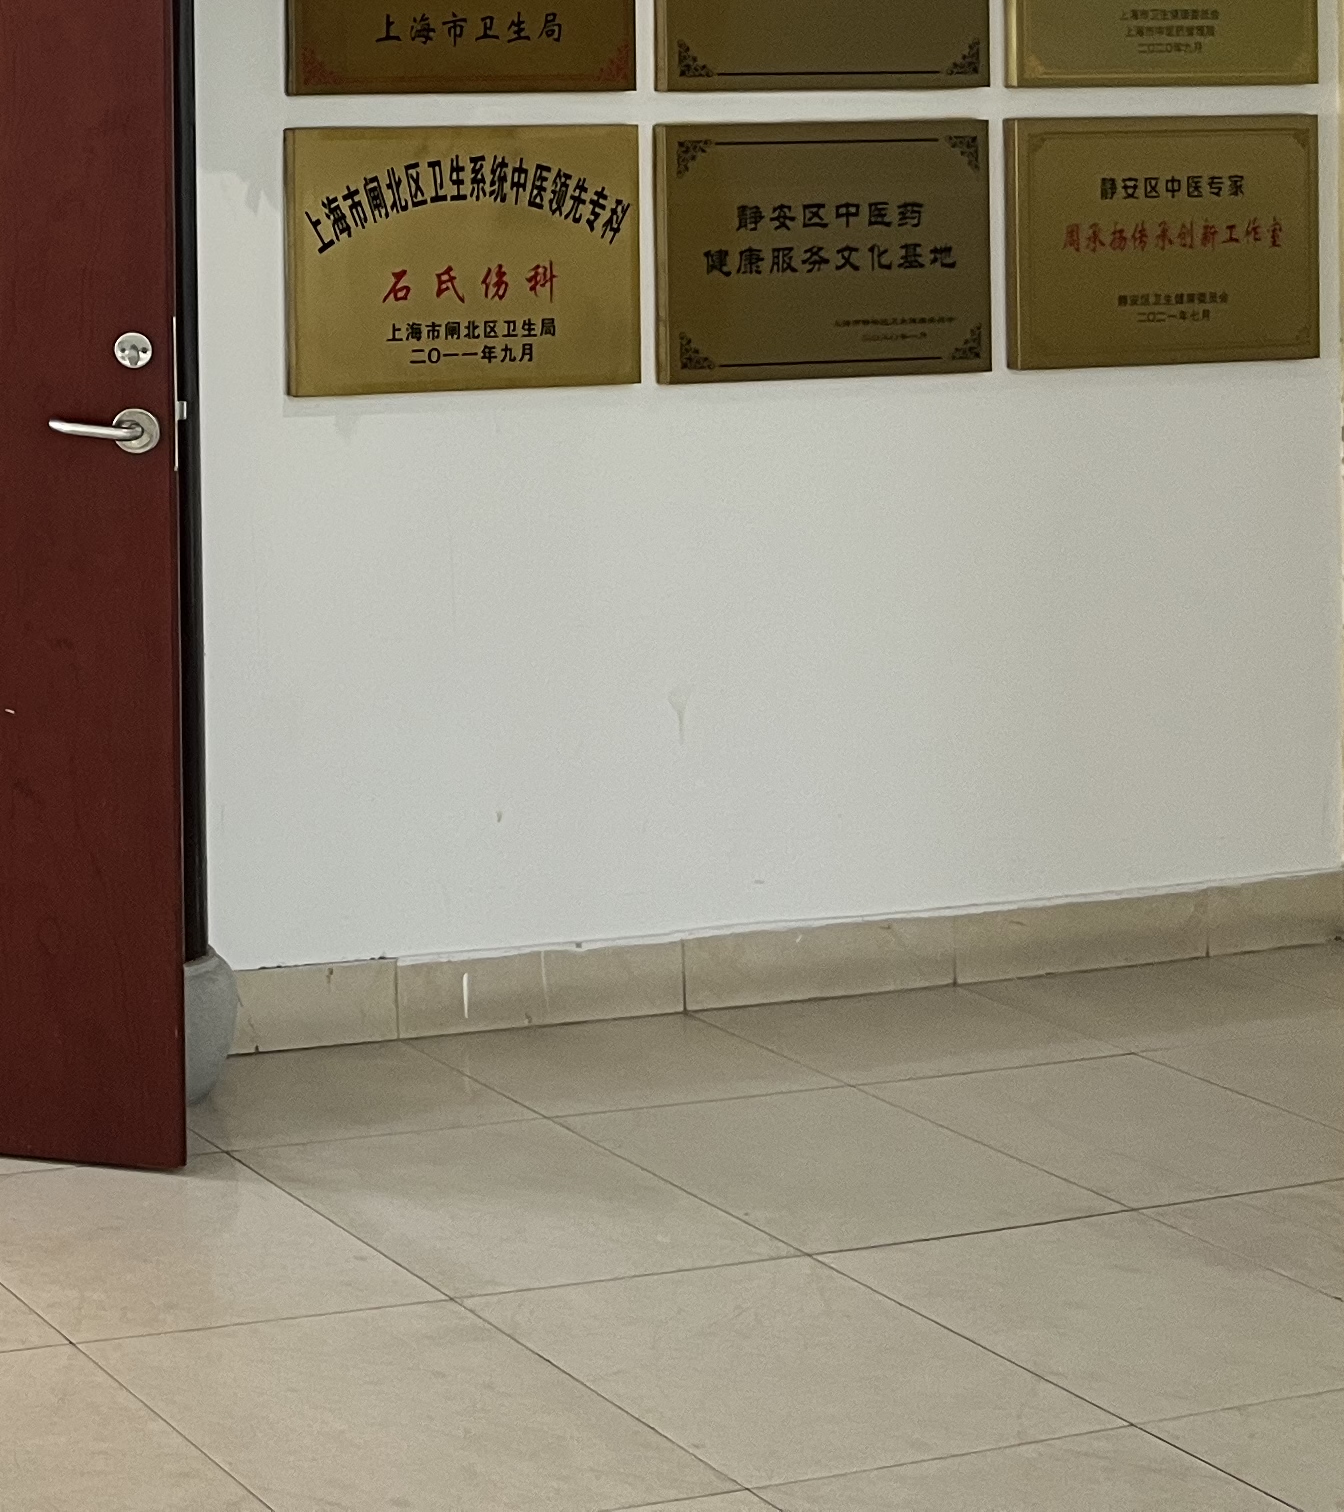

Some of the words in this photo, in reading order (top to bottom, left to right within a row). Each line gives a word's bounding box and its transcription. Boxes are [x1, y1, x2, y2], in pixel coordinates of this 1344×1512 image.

[374, 10, 564, 48] 上海市卫生局
[304, 153, 631, 255] 上海市闸北区卫生系统中医领先专科
[1099, 174, 1246, 201] 静安区中医专家
[735, 201, 925, 233] 静安区中医药
[703, 243, 958, 278] 健康服务文化基地
[381, 259, 559, 305] 石氏伤科
[385, 317, 558, 343] 上海市闸北区卫生局
